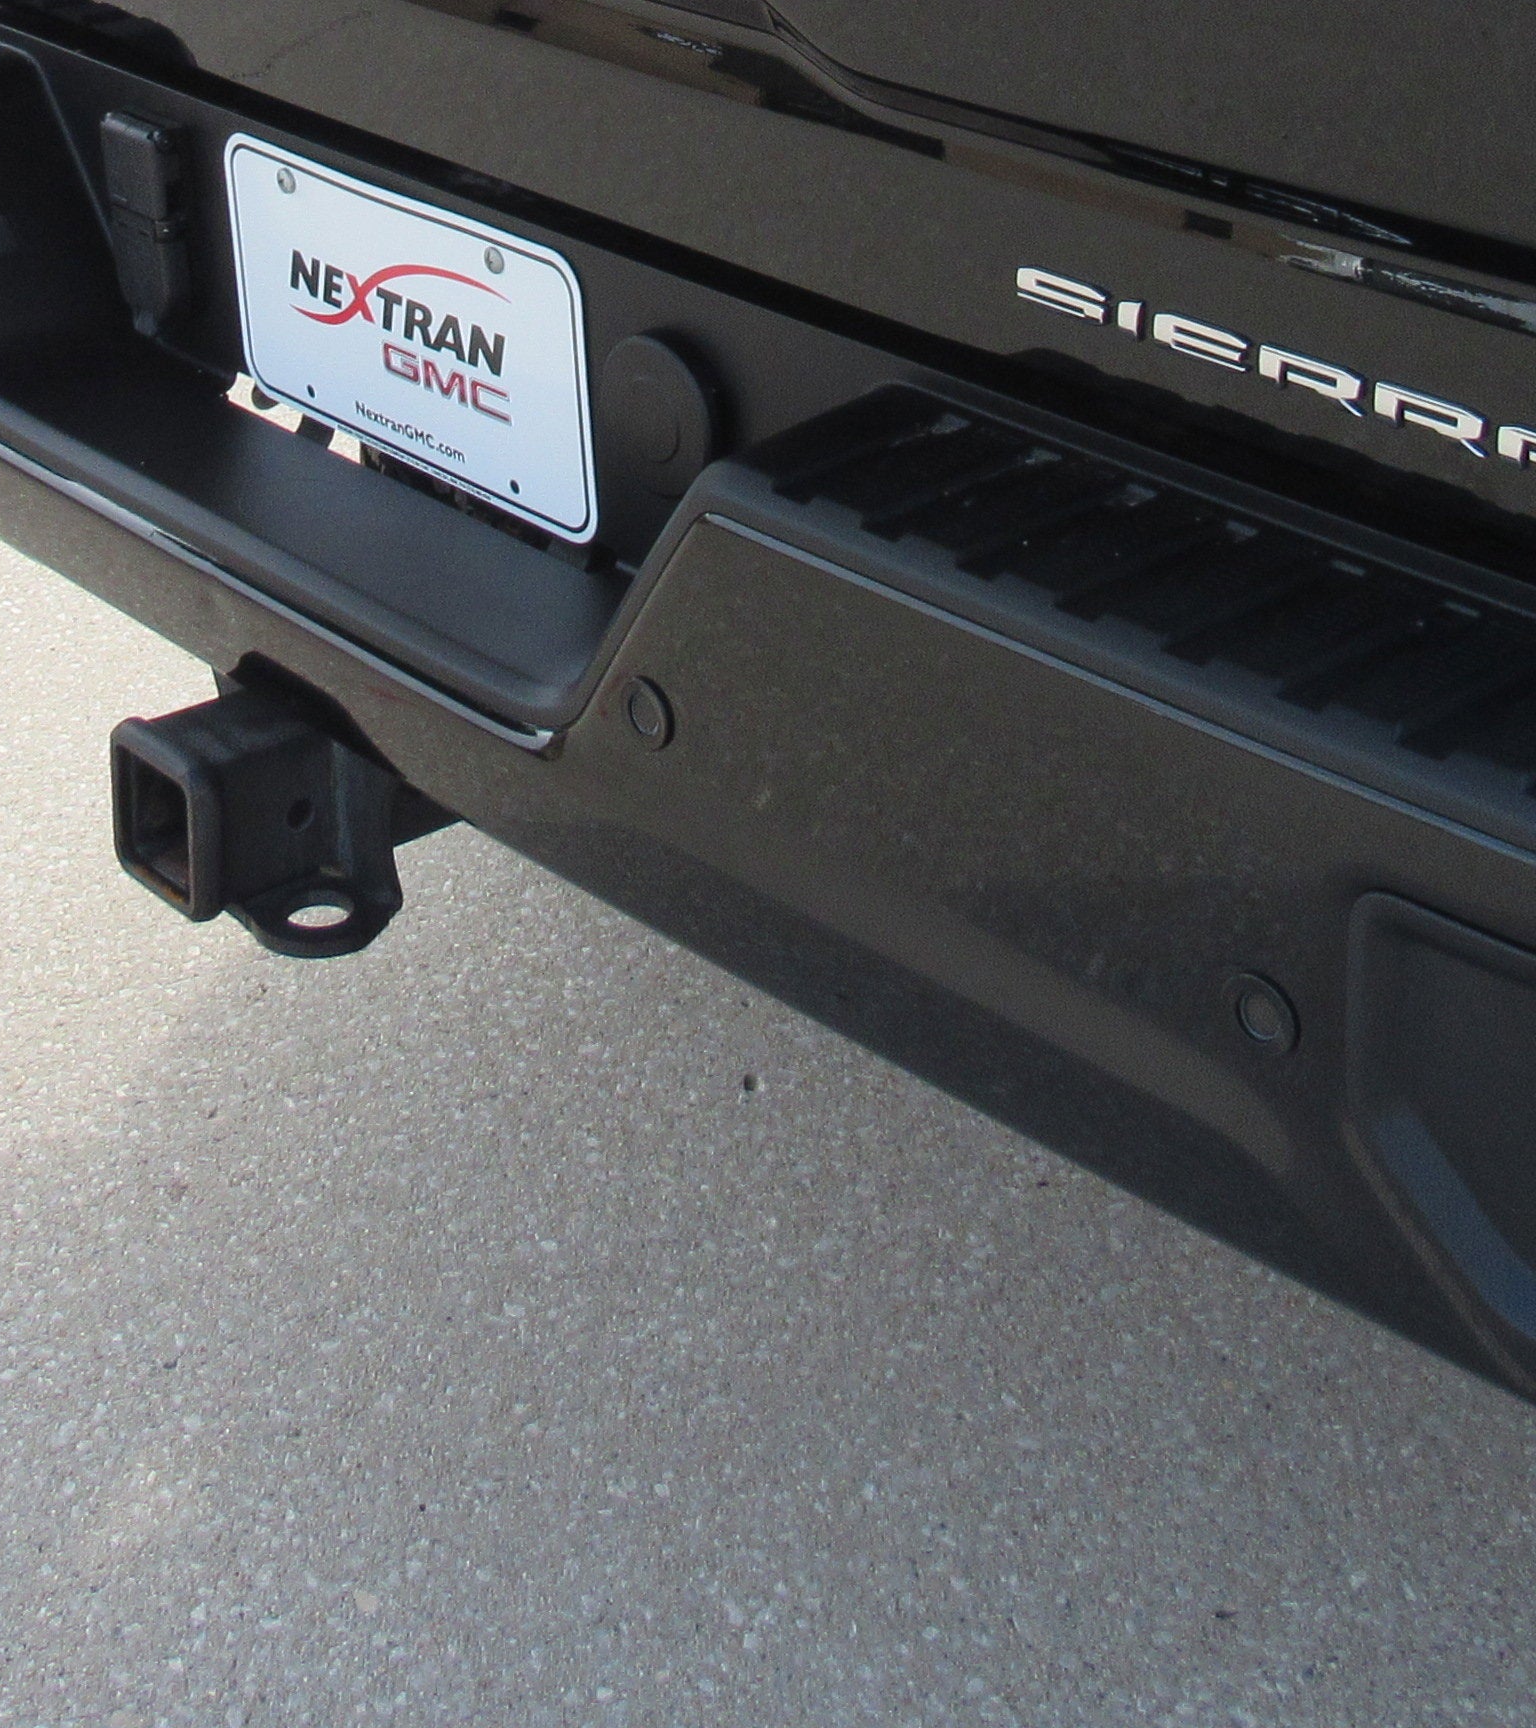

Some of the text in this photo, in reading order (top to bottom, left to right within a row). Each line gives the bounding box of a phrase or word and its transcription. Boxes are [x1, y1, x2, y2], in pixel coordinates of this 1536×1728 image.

[290, 249, 506, 377] NEXTRAN
[381, 339, 512, 426] GMC
[355, 400, 466, 464] NextranGMC.com
